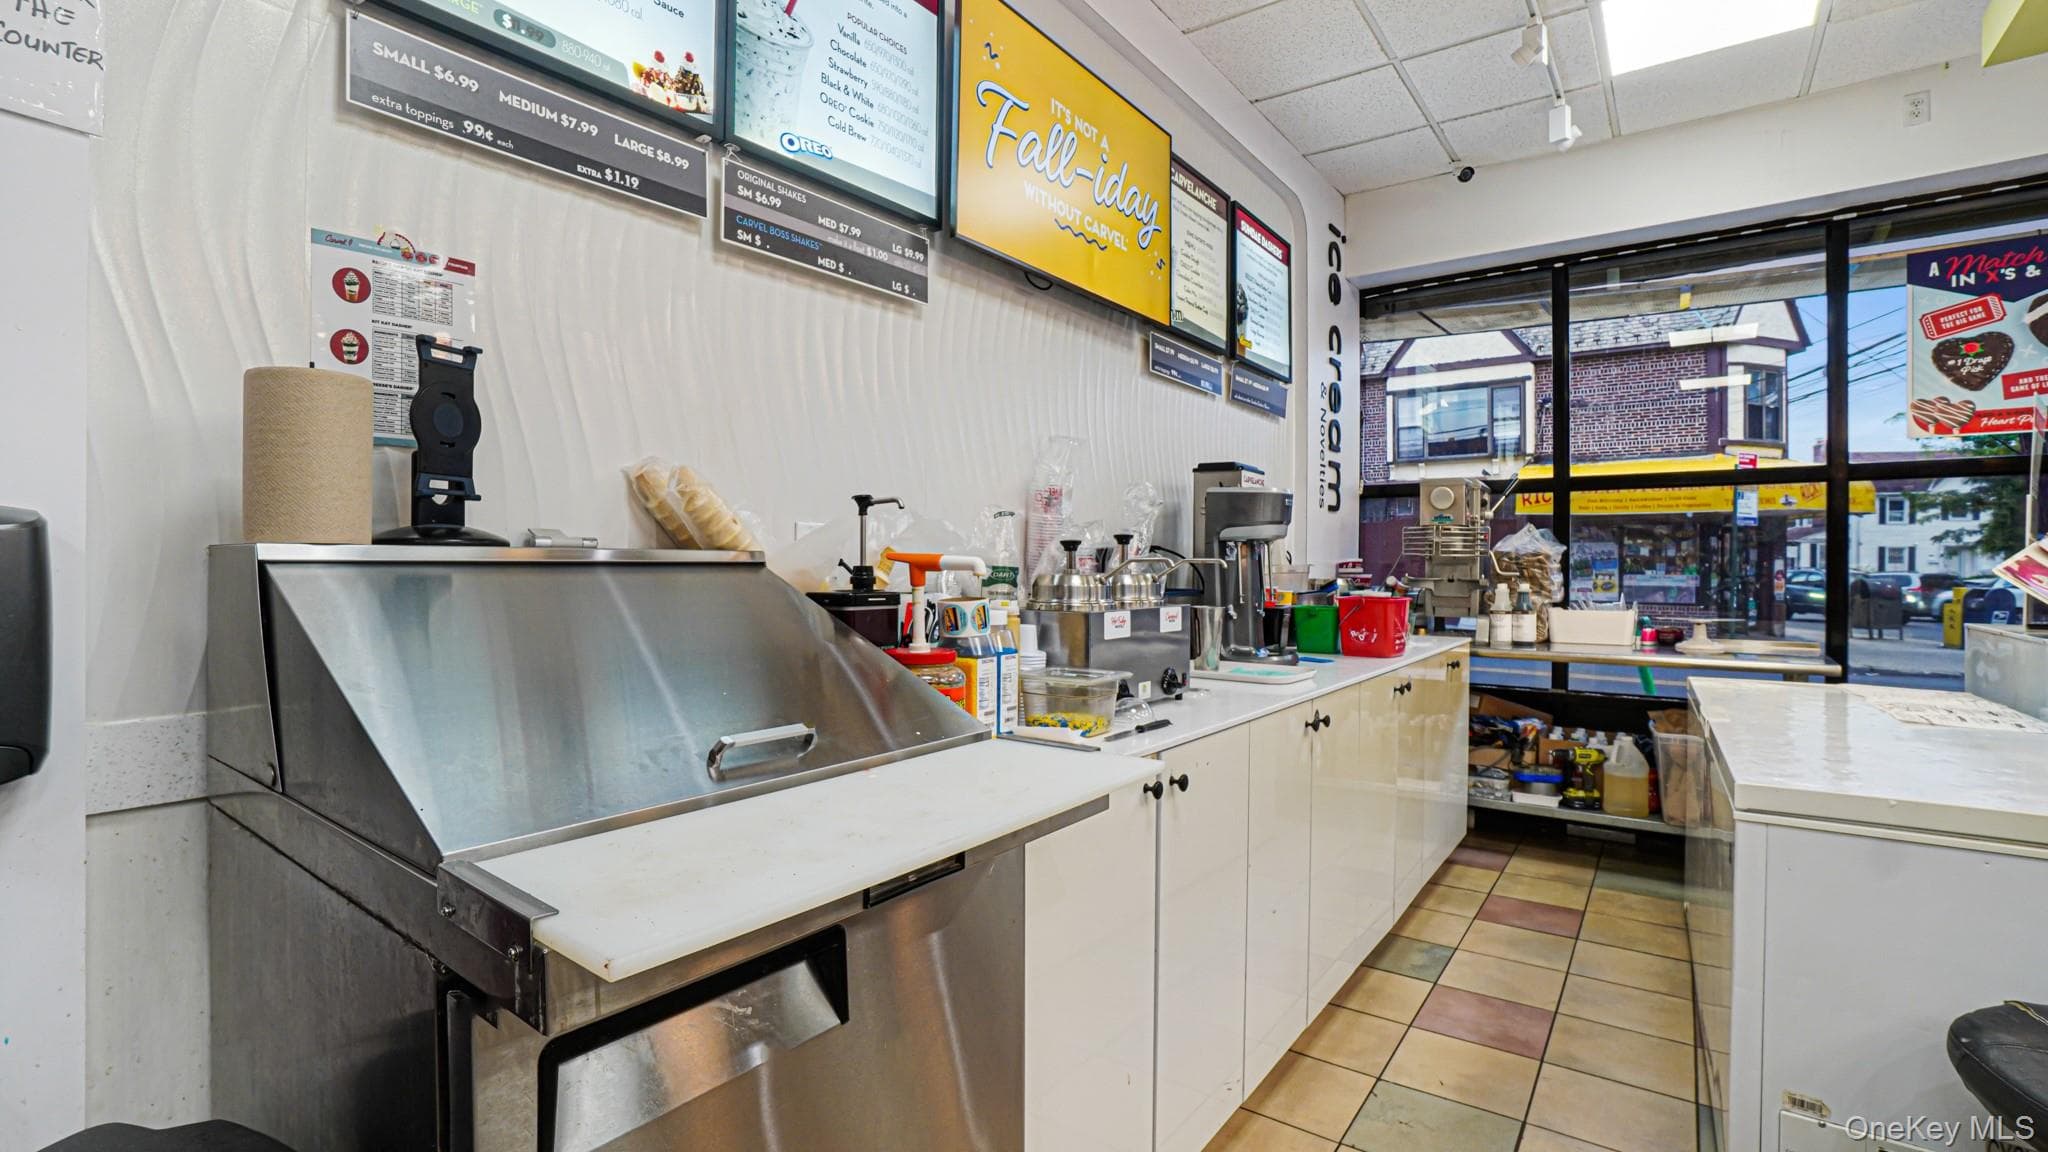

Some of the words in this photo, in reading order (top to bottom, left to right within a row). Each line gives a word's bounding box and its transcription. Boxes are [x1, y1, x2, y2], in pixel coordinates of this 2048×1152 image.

[837, 23, 860, 46] Vanilla
[847, 11, 878, 37] POPULAR
[879, 32, 908, 55] CHOICES
[829, 39, 867, 69] Chocolate
[827, 57, 869, 89] Strawberry
[820, 72, 842, 94] Black
[843, 83, 850, 97] &
[851, 87, 874, 109] White
[371, 40, 431, 76] SMALL
[433, 64, 480, 93] $6.99
[499, 89, 559, 123] MEDIUM
[559, 112, 599, 137] $7.99
[613, 133, 655, 159] LARGE
[656, 149, 690, 171] $8.99
[849, 106, 874, 128] Cookie
[371, 94, 403, 111] extra
[404, 102, 454, 131] toppings
[497, 138, 515, 150] each
[827, 115, 847, 134] Cold
[848, 124, 868, 143] Brew
[1050, 97, 1073, 125] IT'S
[1074, 115, 1098, 144] NOT
[1100, 134, 1110, 152] A
[575, 163, 602, 180] EXTRA
[603, 166, 640, 190] $1.19
[976, 79, 1162, 251] Fall-iday
[736, 168, 777, 192] ORIGINAL
[776, 183, 807, 204] SHAKES
[736, 184, 753, 200] SM
[754, 190, 782, 208] $6.99
[1023, 179, 1082, 229] WITHOUT
[735, 214, 768, 234] CARVEL
[769, 226, 789, 241] BOSS
[736, 229, 753, 243] SM
[817, 214, 837, 230] MED
[839, 222, 862, 239] $7.99
[817, 255, 837, 270] MED
[866, 246, 889, 261] $1.00
[891, 243, 903, 255] LG
[904, 246, 925, 262] $9.99
[1327, 222, 1348, 306] ice
[1928, 261, 1941, 278] A
[1944, 245, 2048, 282] Match
[891, 280, 903, 292] LG
[1950, 273, 1977, 288] IN
[1985, 265, 2017, 285] X'S
[2024, 263, 2042, 278] &
[1939, 310, 1969, 324] PERFECT
[1969, 306, 1984, 315] FOR
[1968, 312, 1987, 322] GAME
[2009, 384, 2029, 393] GAME
[1327, 325, 1342, 513] cream
[1980, 415, 2016, 428] Heart
[1319, 407, 1327, 509] Novelties
[992, 570, 1013, 579] DART
